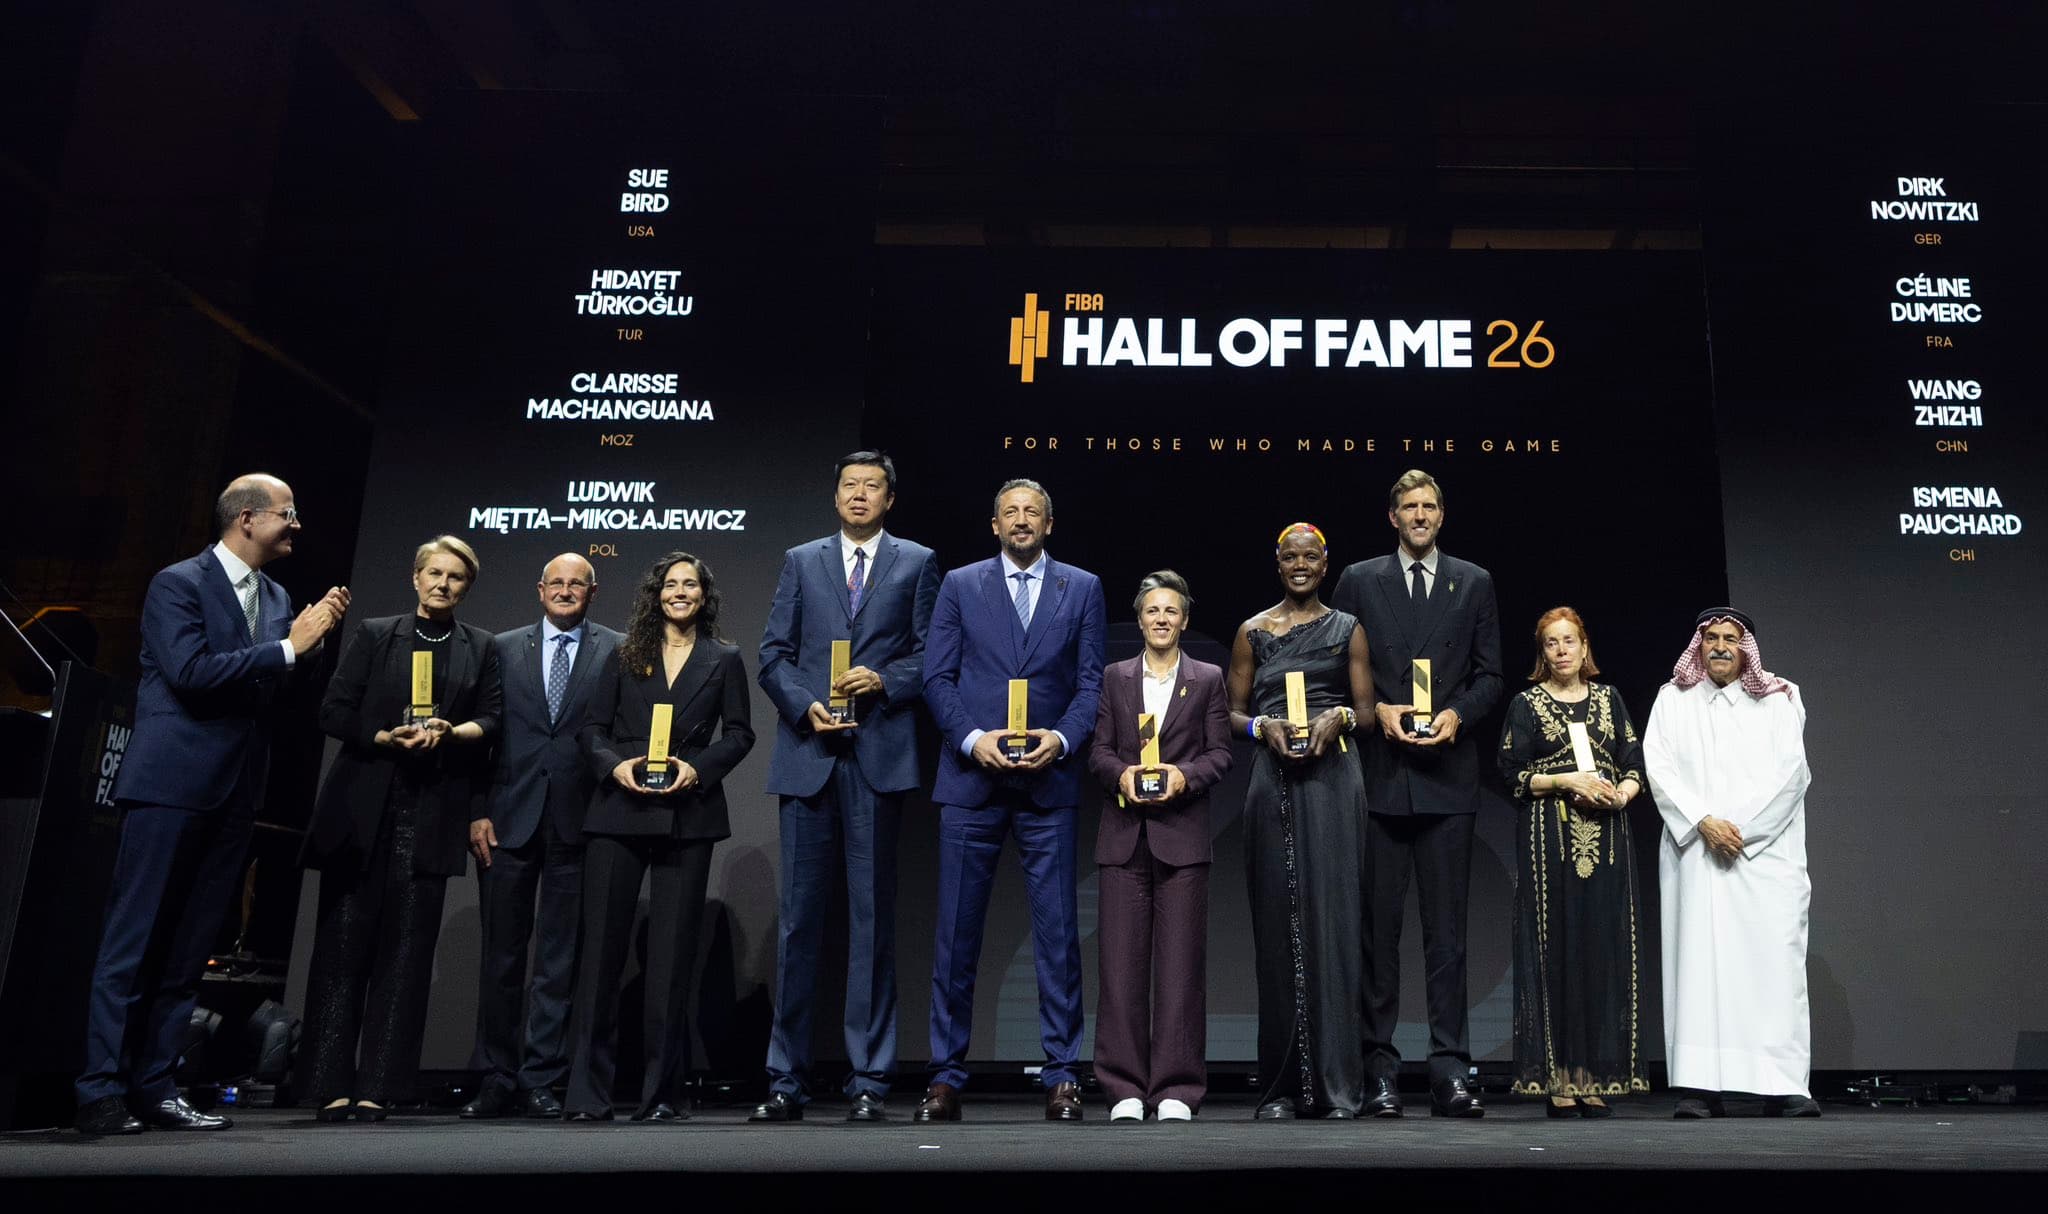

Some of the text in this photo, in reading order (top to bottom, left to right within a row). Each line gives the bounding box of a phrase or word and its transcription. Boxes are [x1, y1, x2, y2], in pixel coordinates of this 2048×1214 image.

[628, 169, 669, 189] SUE
[1898, 177, 1946, 197] DIRK
[621, 193, 670, 213] BIRD
[1871, 201, 1980, 222] NOWITZKI
[627, 225, 655, 237] USA
[1914, 233, 1942, 245] GER
[591, 270, 681, 290] HIDAYET
[1896, 273, 1971, 298] CÉLINE
[575, 292, 693, 316] TÜRKOĞLU
[1065, 293, 1104, 311] FIBA
[1891, 302, 1982, 323] DUMERC
[617, 328, 643, 341] TUR
[1063, 317, 1556, 369] HALL OF FAME 26
[1926, 336, 1953, 348] FRA
[571, 373, 678, 394] CLARISSE
[1908, 380, 1982, 401] WANG
[527, 399, 714, 421] MACHANGUANA
[1914, 405, 1983, 427] ZHIZHI
[601, 434, 634, 447] MOZ
[1004, 437, 1560, 452] FOR THOSE WHO MADE THE GAME
[1935, 440, 1968, 453] CHN
[567, 481, 656, 503] LUDWIK
[1913, 487, 2003, 509] ISMENIA
[1900, 514, 2022, 536] PAUCHARD
[589, 543, 619, 558] POL
[1949, 548, 1975, 561] CHI
[101, 752, 122, 778] OF
